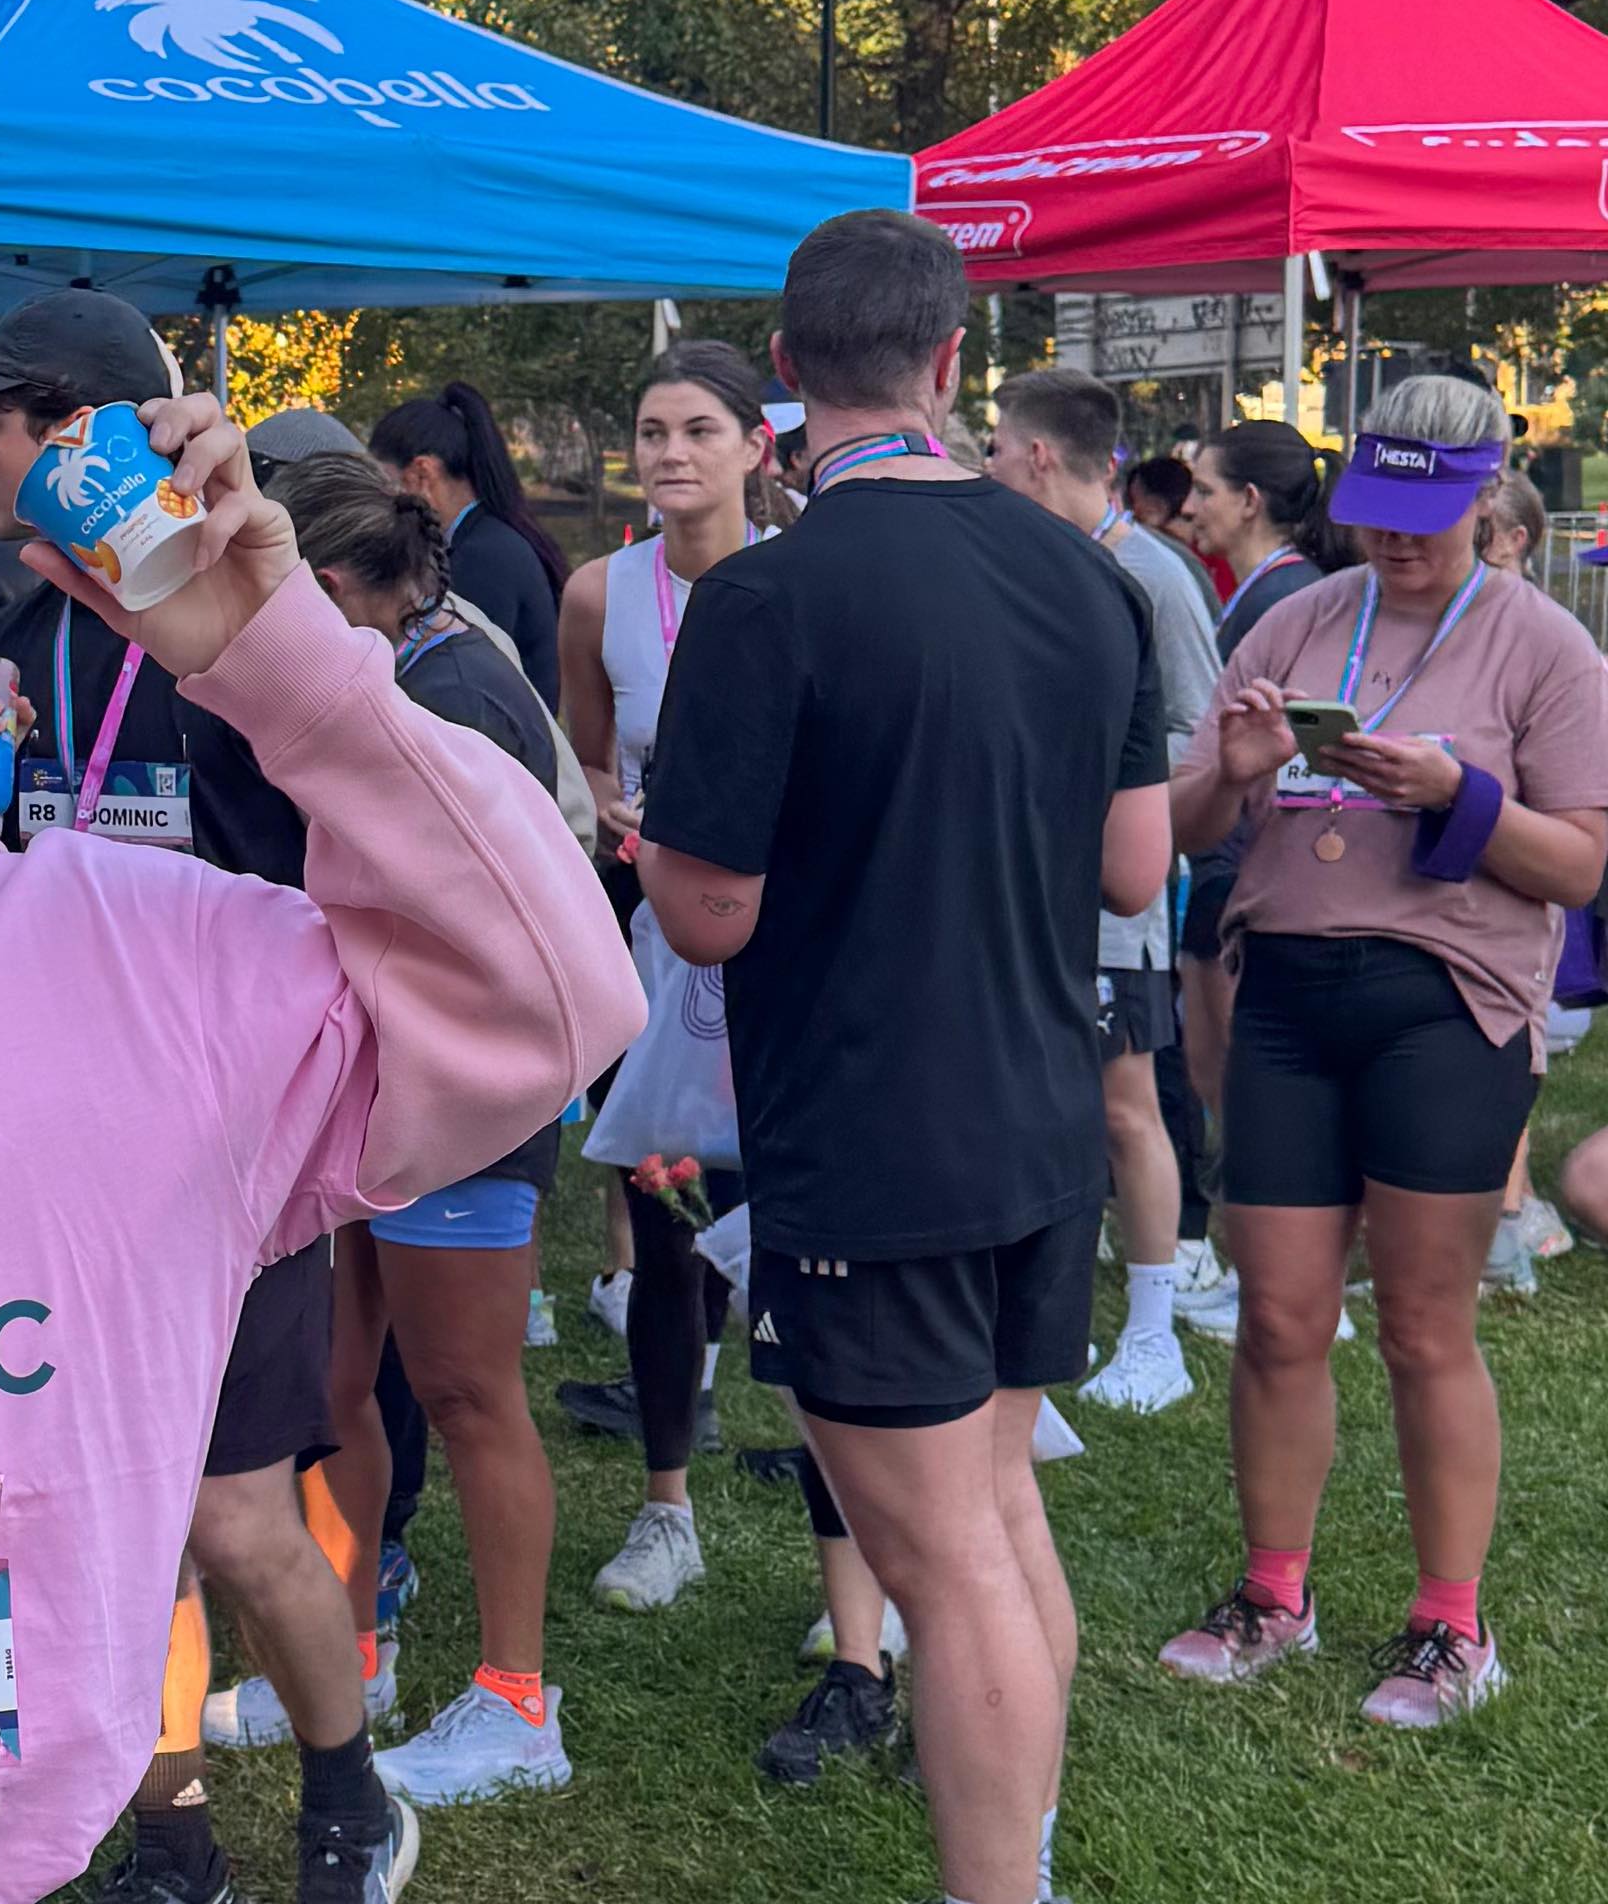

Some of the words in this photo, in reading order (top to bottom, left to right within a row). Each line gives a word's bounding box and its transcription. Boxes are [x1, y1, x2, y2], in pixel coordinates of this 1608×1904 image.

[88, 68, 552, 112] cocobella
[1379, 447, 1427, 470] HESTA
[81, 472, 147, 535] cocobella
[29, 803, 56, 822] R8
